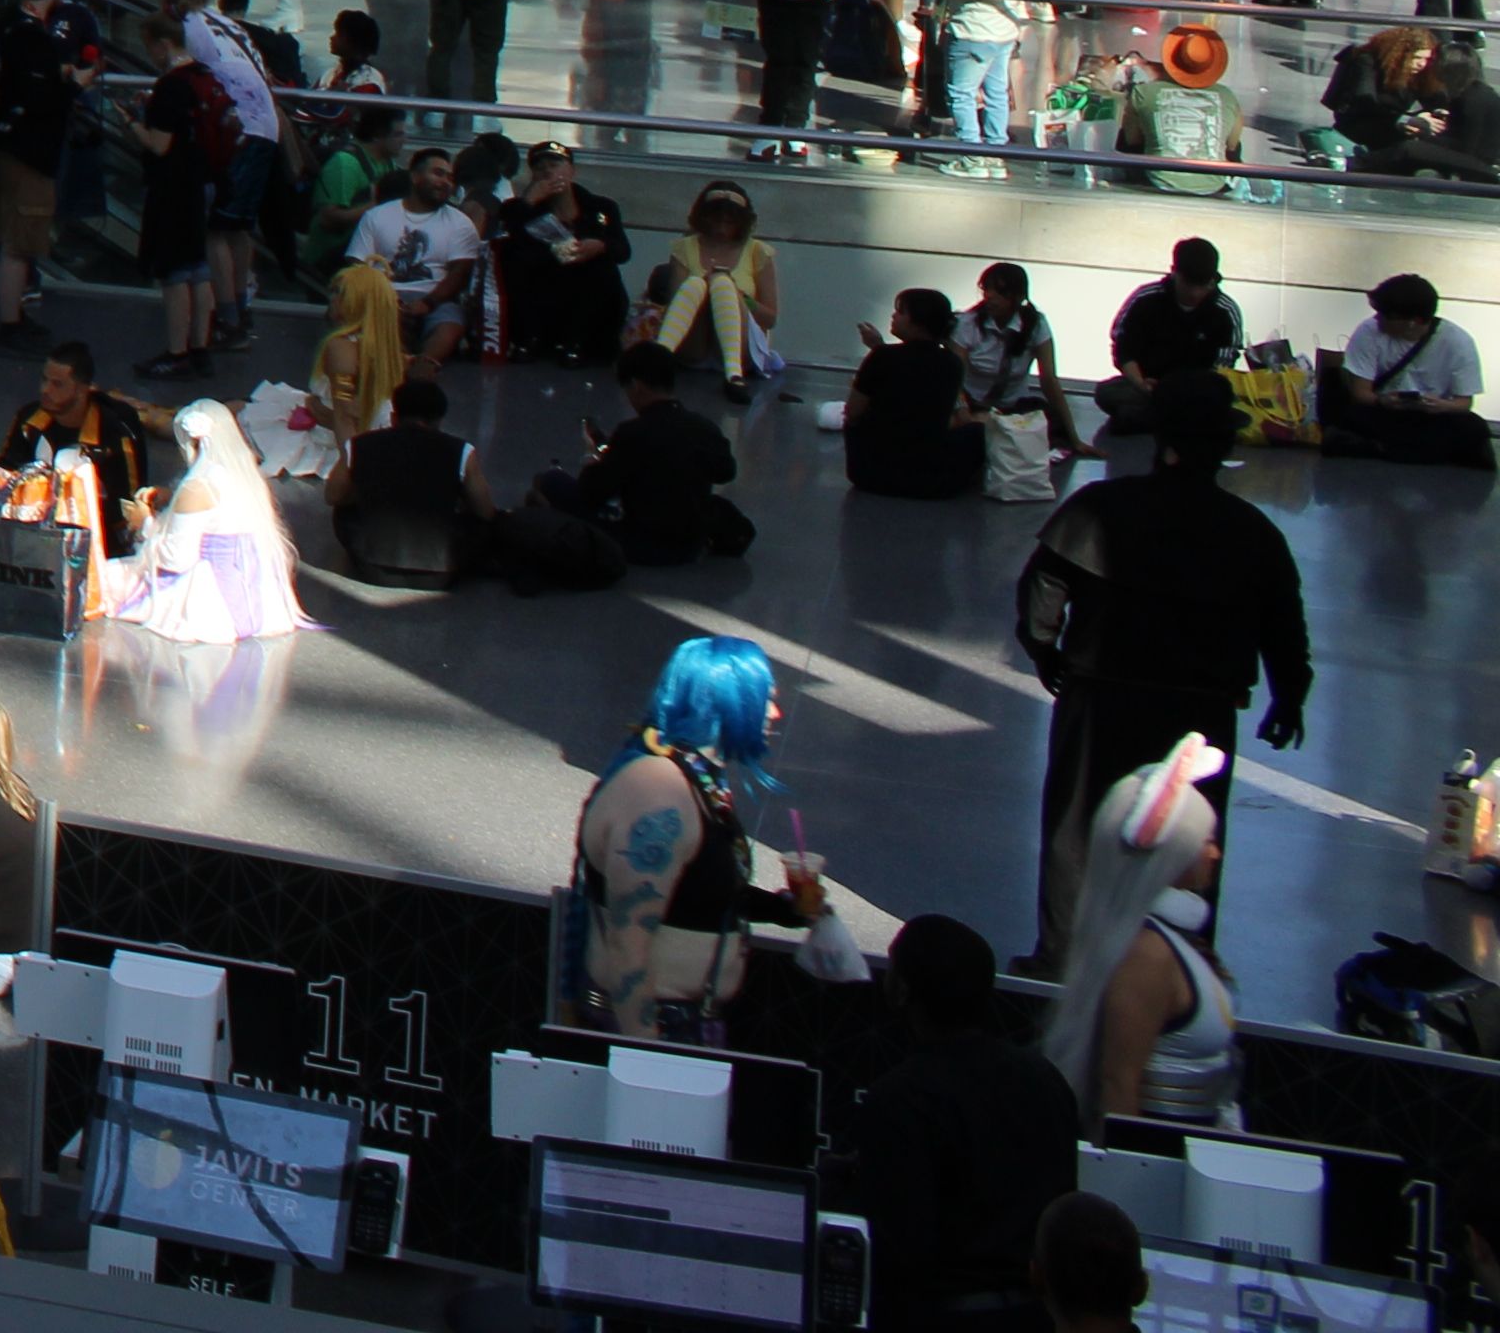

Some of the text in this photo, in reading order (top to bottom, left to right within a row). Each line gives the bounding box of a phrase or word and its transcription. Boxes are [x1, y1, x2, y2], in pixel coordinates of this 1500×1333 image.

[303, 974, 443, 1092] 11
[195, 1145, 302, 1189] JAVITS
[189, 1180, 298, 1219] CENTER
[189, 1275, 237, 1296] SELF
